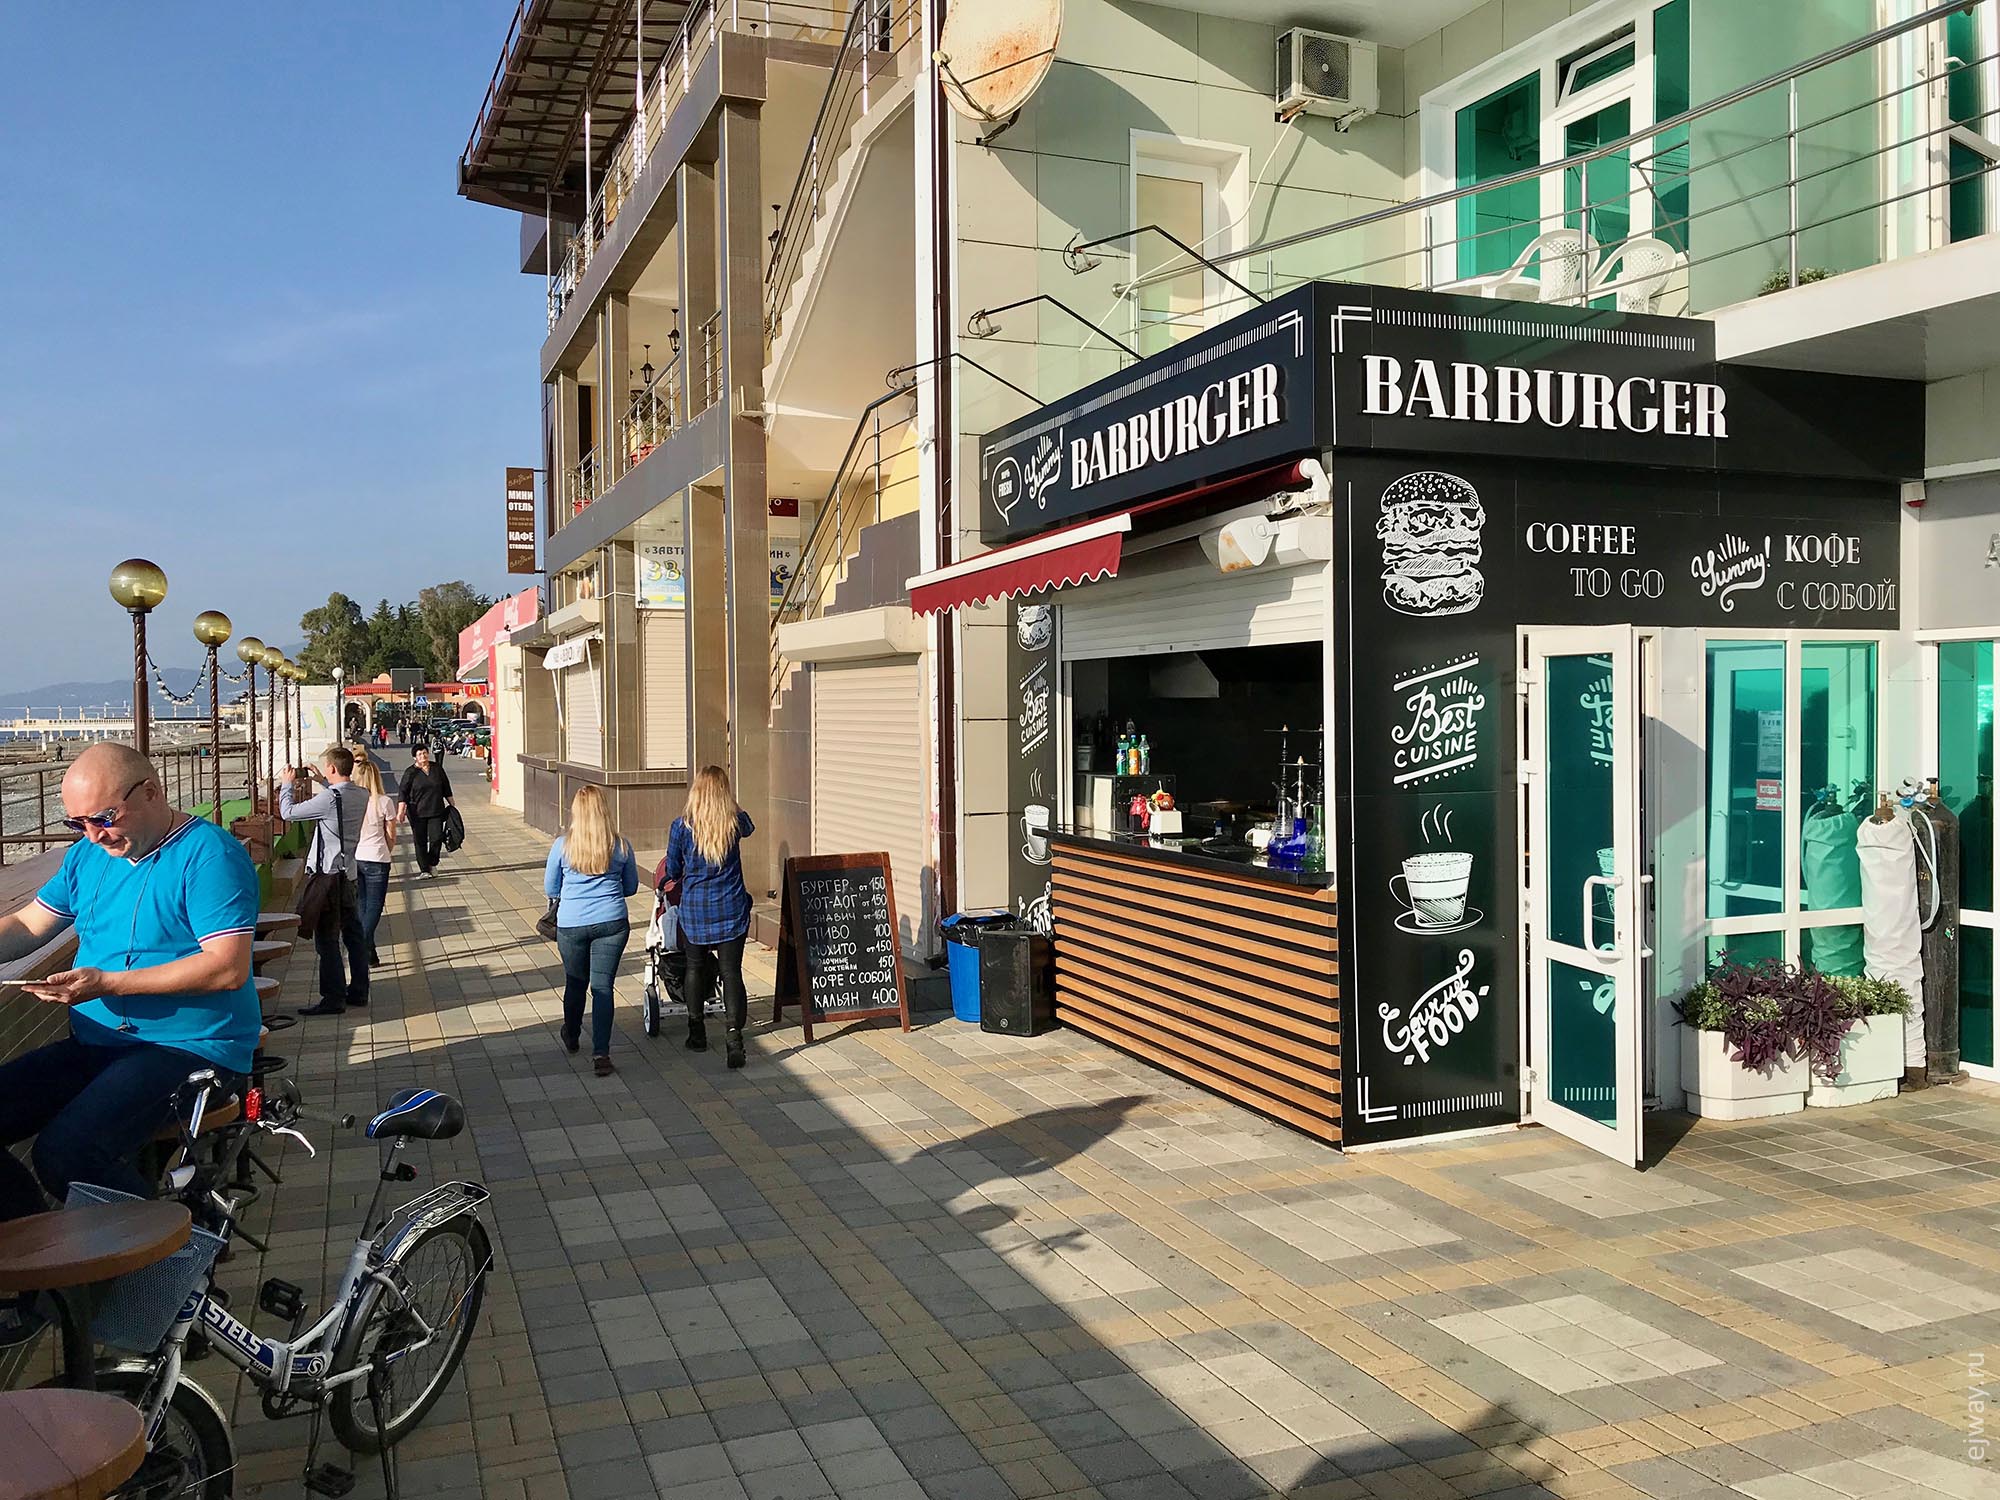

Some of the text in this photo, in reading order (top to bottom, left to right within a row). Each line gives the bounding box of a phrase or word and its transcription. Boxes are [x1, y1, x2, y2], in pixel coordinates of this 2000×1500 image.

[1362, 354, 1729, 438] BARBURGER
[1070, 363, 1280, 490] BARBURGER
[1024, 427, 1063, 509] Yummy!
[508, 490, 533, 500] МИНИ
[508, 502, 534, 512] ОТЕЛЬ
[508, 531, 534, 542] КАФЕ
[1525, 522, 1637, 555] COFFEE
[1784, 532, 1861, 568] КОФЕ
[1570, 567, 1665, 599] TO GO
[1691, 535, 1771, 613] Yummy!
[1776, 578, 1897, 611] С СОБОЙ
[1019, 685, 1050, 727] Best
[1392, 685, 1486, 745] Best
[1020, 711, 1048, 743] CUISINE
[1394, 730, 1478, 768] CUISINE
[800, 876, 886, 896] БУРГЕР от 150
[806, 894, 858, 911] ХОТ-ДОГ
[871, 893, 887, 906] 150
[806, 922, 891, 941] ПИВО 100
[809, 942, 857, 957] МОХИТО
[875, 939, 892, 953] 150
[878, 954, 895, 969] 150
[812, 973, 844, 990] КОФЕ
[858, 968, 893, 984] СОБОЙ
[823, 963, 858, 973] КОКТЕЙЛИ
[813, 987, 899, 1009] КАЛЬЯН 400
[1378, 948, 1475, 1053] Gourmet
[1410, 990, 1480, 1064] FOOD
[204, 1302, 264, 1356] STELS
